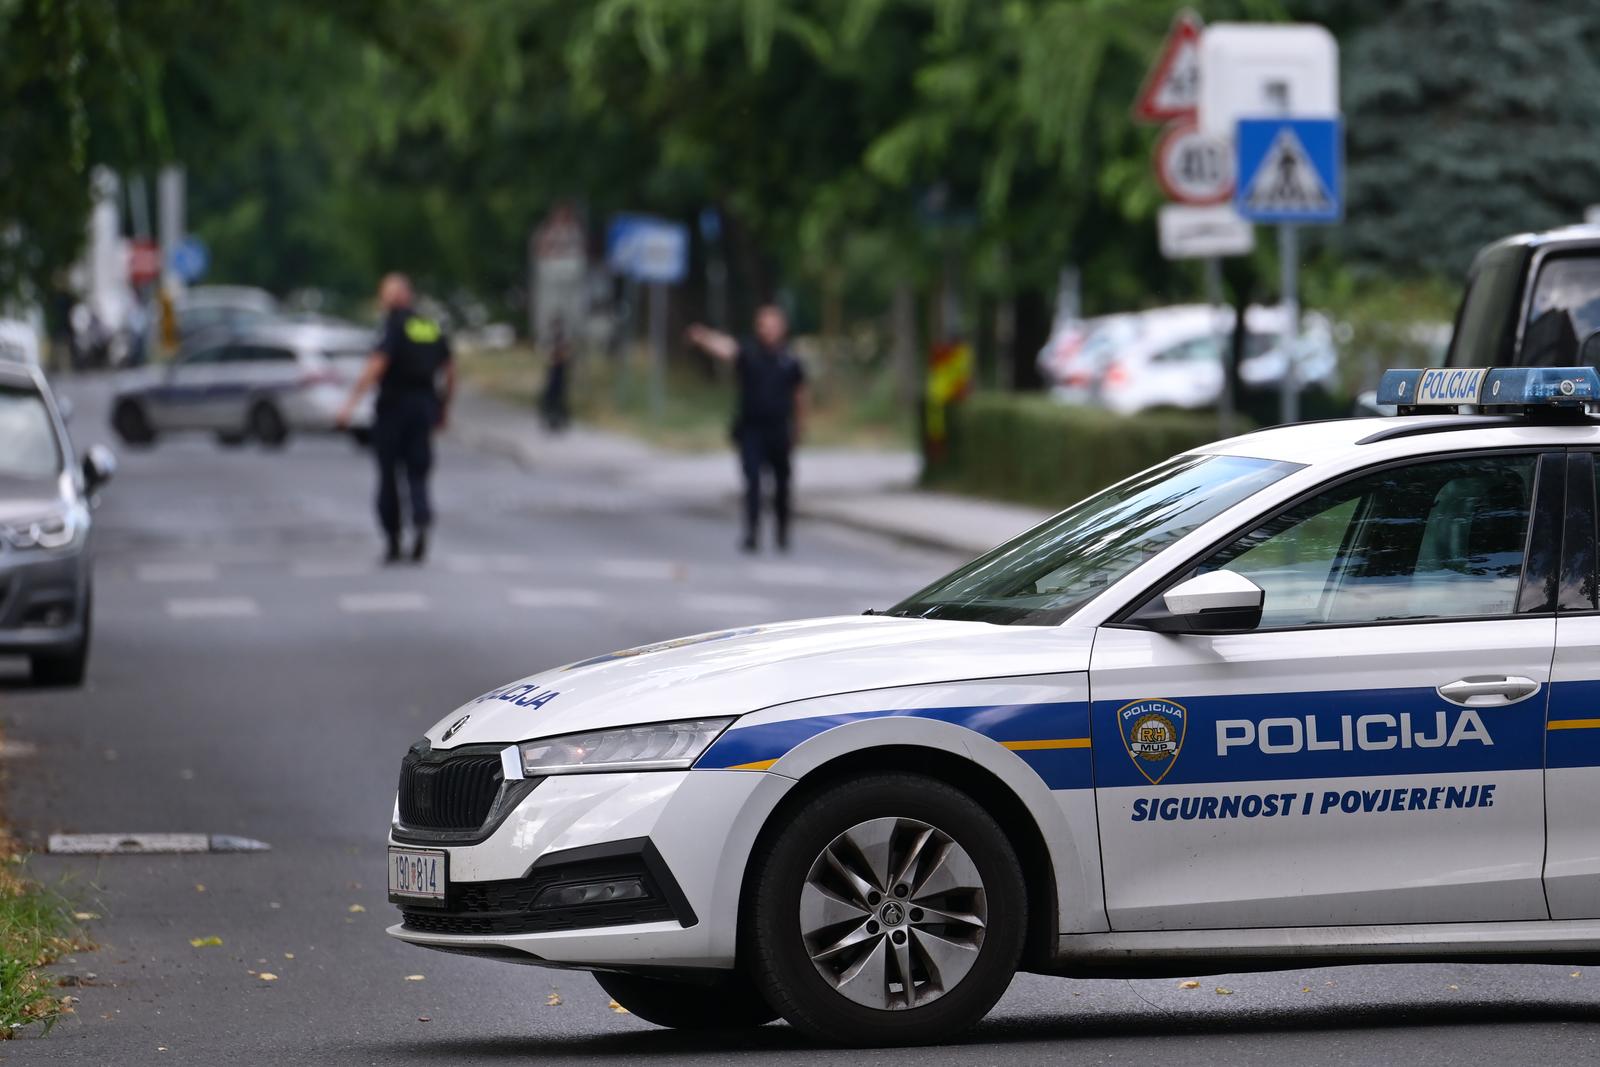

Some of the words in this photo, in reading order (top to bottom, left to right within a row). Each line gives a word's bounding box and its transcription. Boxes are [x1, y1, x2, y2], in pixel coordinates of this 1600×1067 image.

[1421, 371, 1480, 399] POLICIJA
[1123, 703, 1182, 720] POLICIJA
[1140, 743, 1168, 751] MUP
[1216, 710, 1494, 756] POLICIJA
[1131, 793, 1296, 821] SIGURNOST
[1302, 792, 1313, 815] I
[1320, 784, 1496, 814] POVJERENJE
